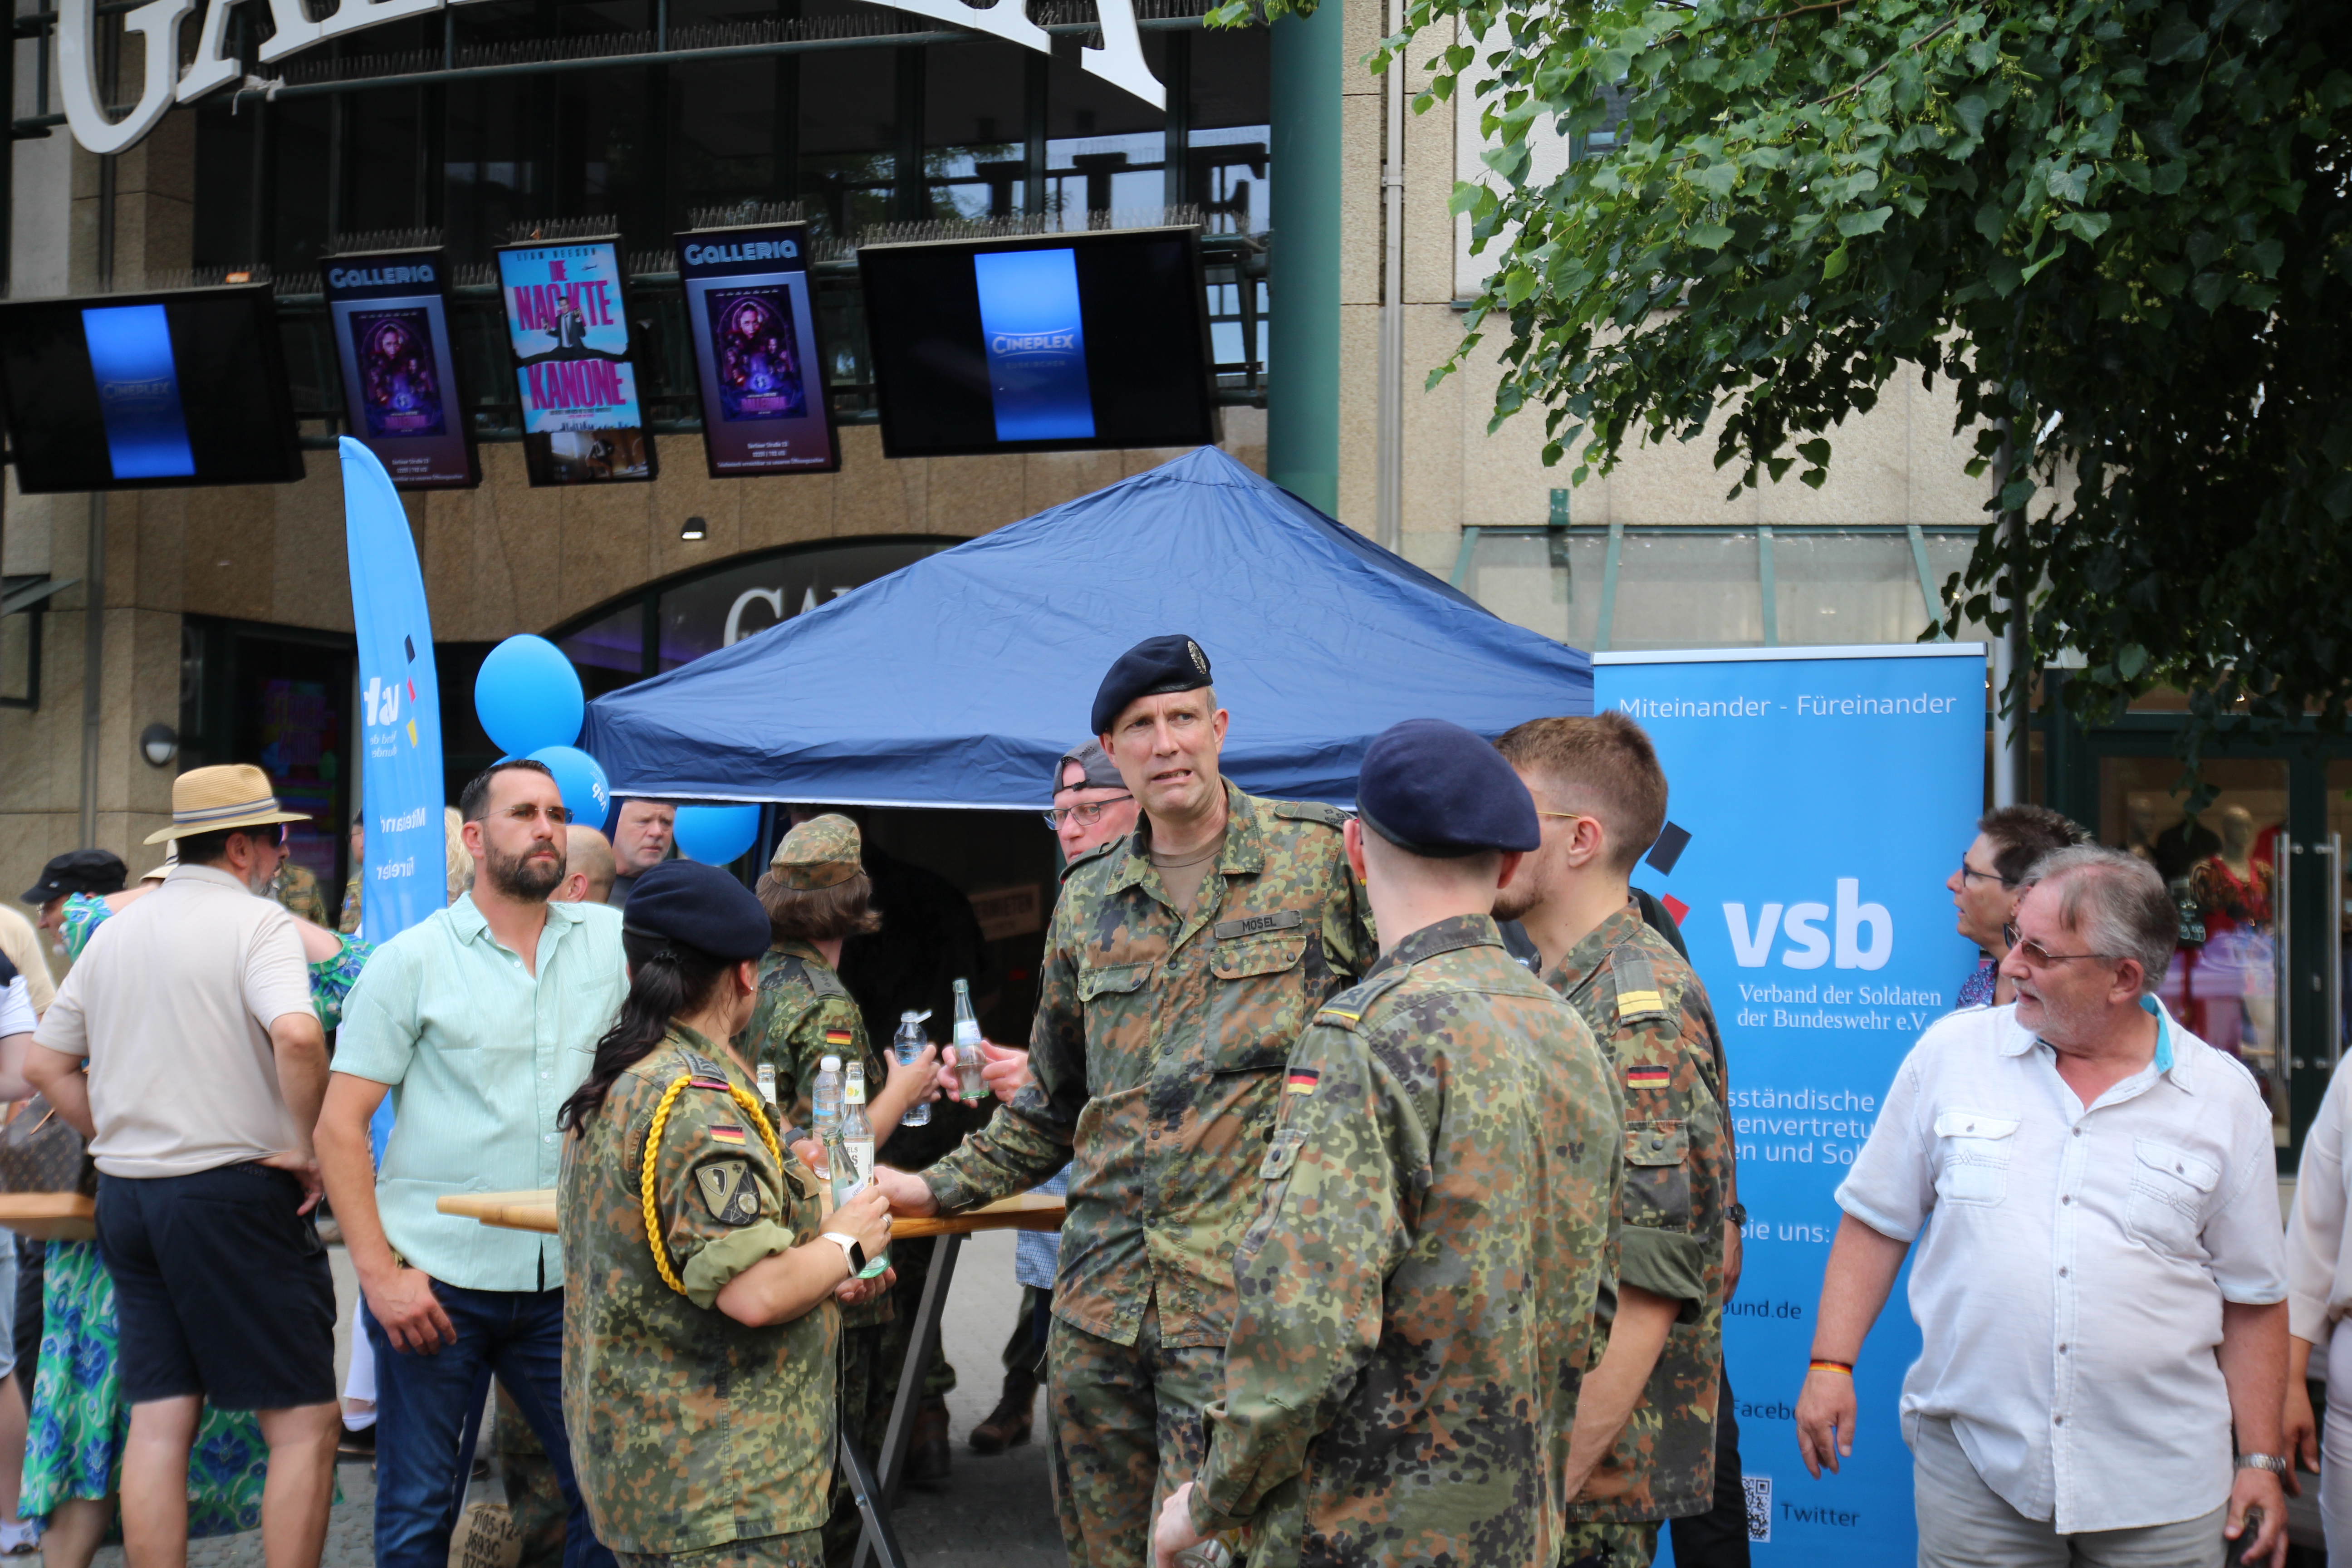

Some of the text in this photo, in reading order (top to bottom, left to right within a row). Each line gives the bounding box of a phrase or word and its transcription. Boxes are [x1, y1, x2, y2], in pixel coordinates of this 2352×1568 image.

[513, 279, 614, 331] NACKTE
[992, 334, 1075, 354] CINEPLEX
[527, 358, 626, 410] KANONE
[1620, 696, 1771, 718] Miteinander
[1797, 693, 1957, 715] Füreinander
[592, 783, 607, 813] vsb
[1242, 917, 1277, 931] MOSEL
[1723, 878, 1893, 970] vsb
[1739, 984, 1941, 1006] Verband der Soldaten
[1738, 1008, 1767, 1026] der
[1773, 1009, 1890, 1029] Bundeswehr
[1732, 1117, 1874, 1139] envertretu
[1766, 1142, 1813, 1163] und
[1779, 1224, 1830, 1243] uns:
[1781, 1503, 1860, 1527] Twitter
